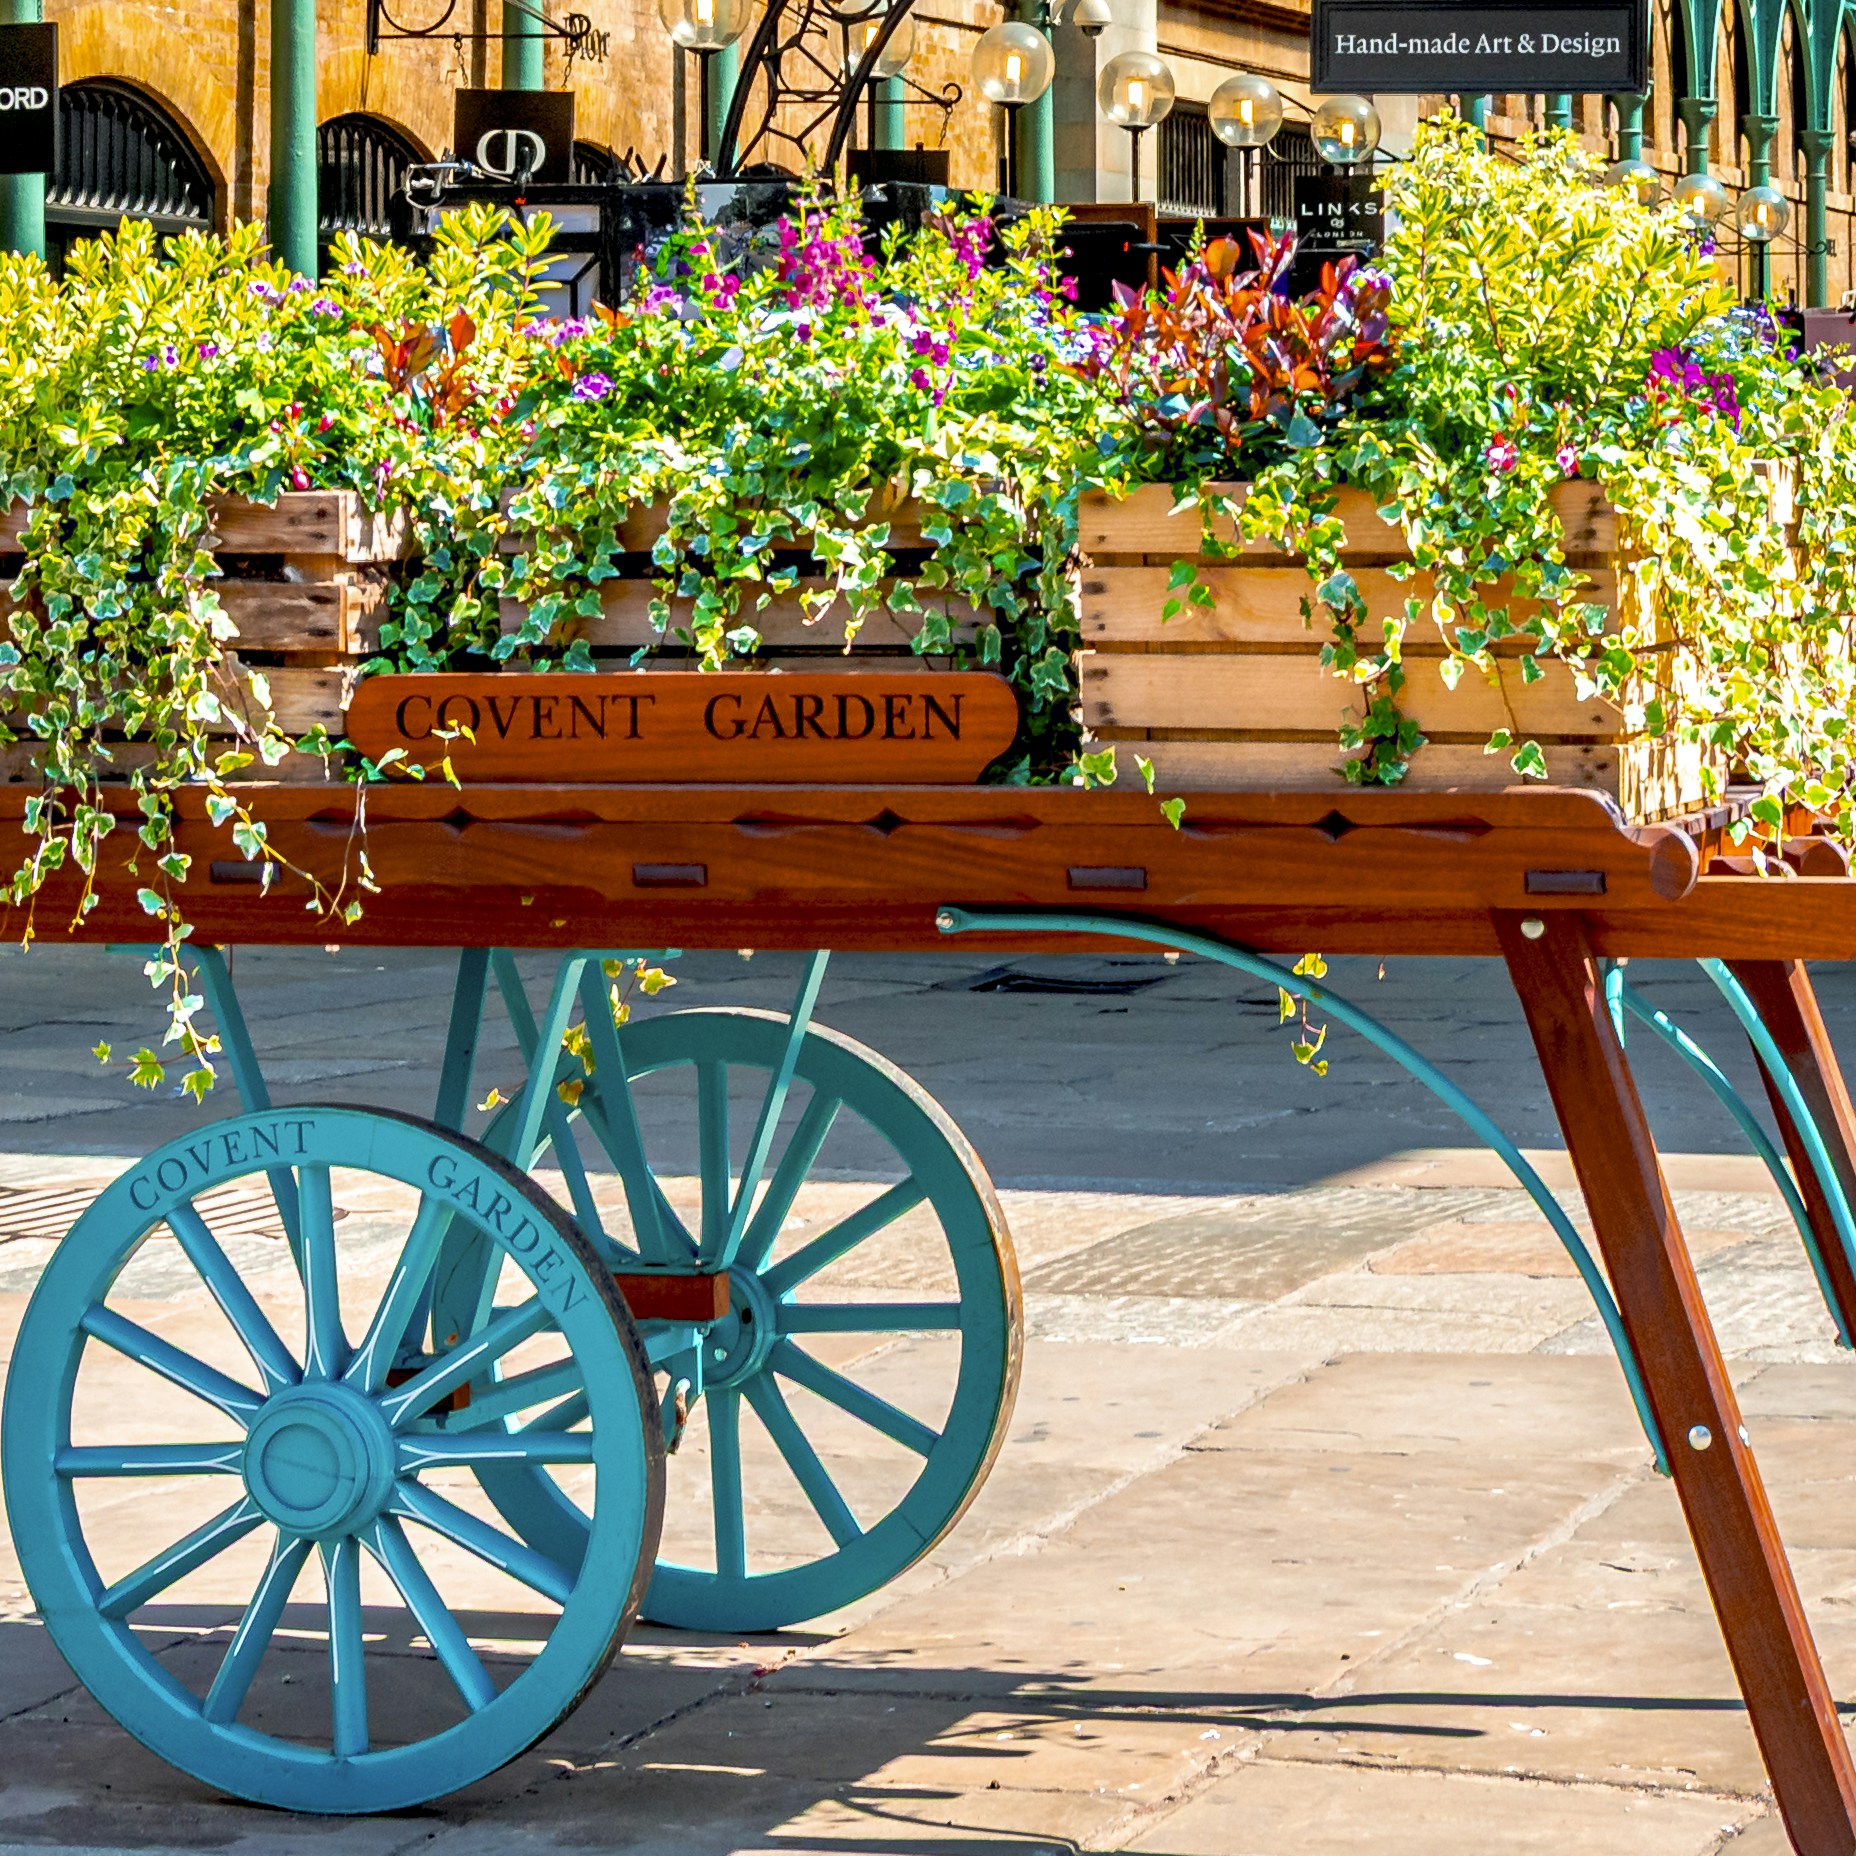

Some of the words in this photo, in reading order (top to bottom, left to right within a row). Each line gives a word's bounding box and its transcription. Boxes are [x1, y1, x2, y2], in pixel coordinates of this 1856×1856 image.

[1334, 32, 1470, 55] Hand-made
[1474, 33, 1512, 54] Art
[1517, 33, 1535, 54] &
[1541, 32, 1621, 58] Design
[395, 694, 655, 740] COVENT
[704, 693, 966, 741] GARDEN
[129, 1120, 316, 1212] COVENT
[427, 1153, 590, 1313] GARDEN
